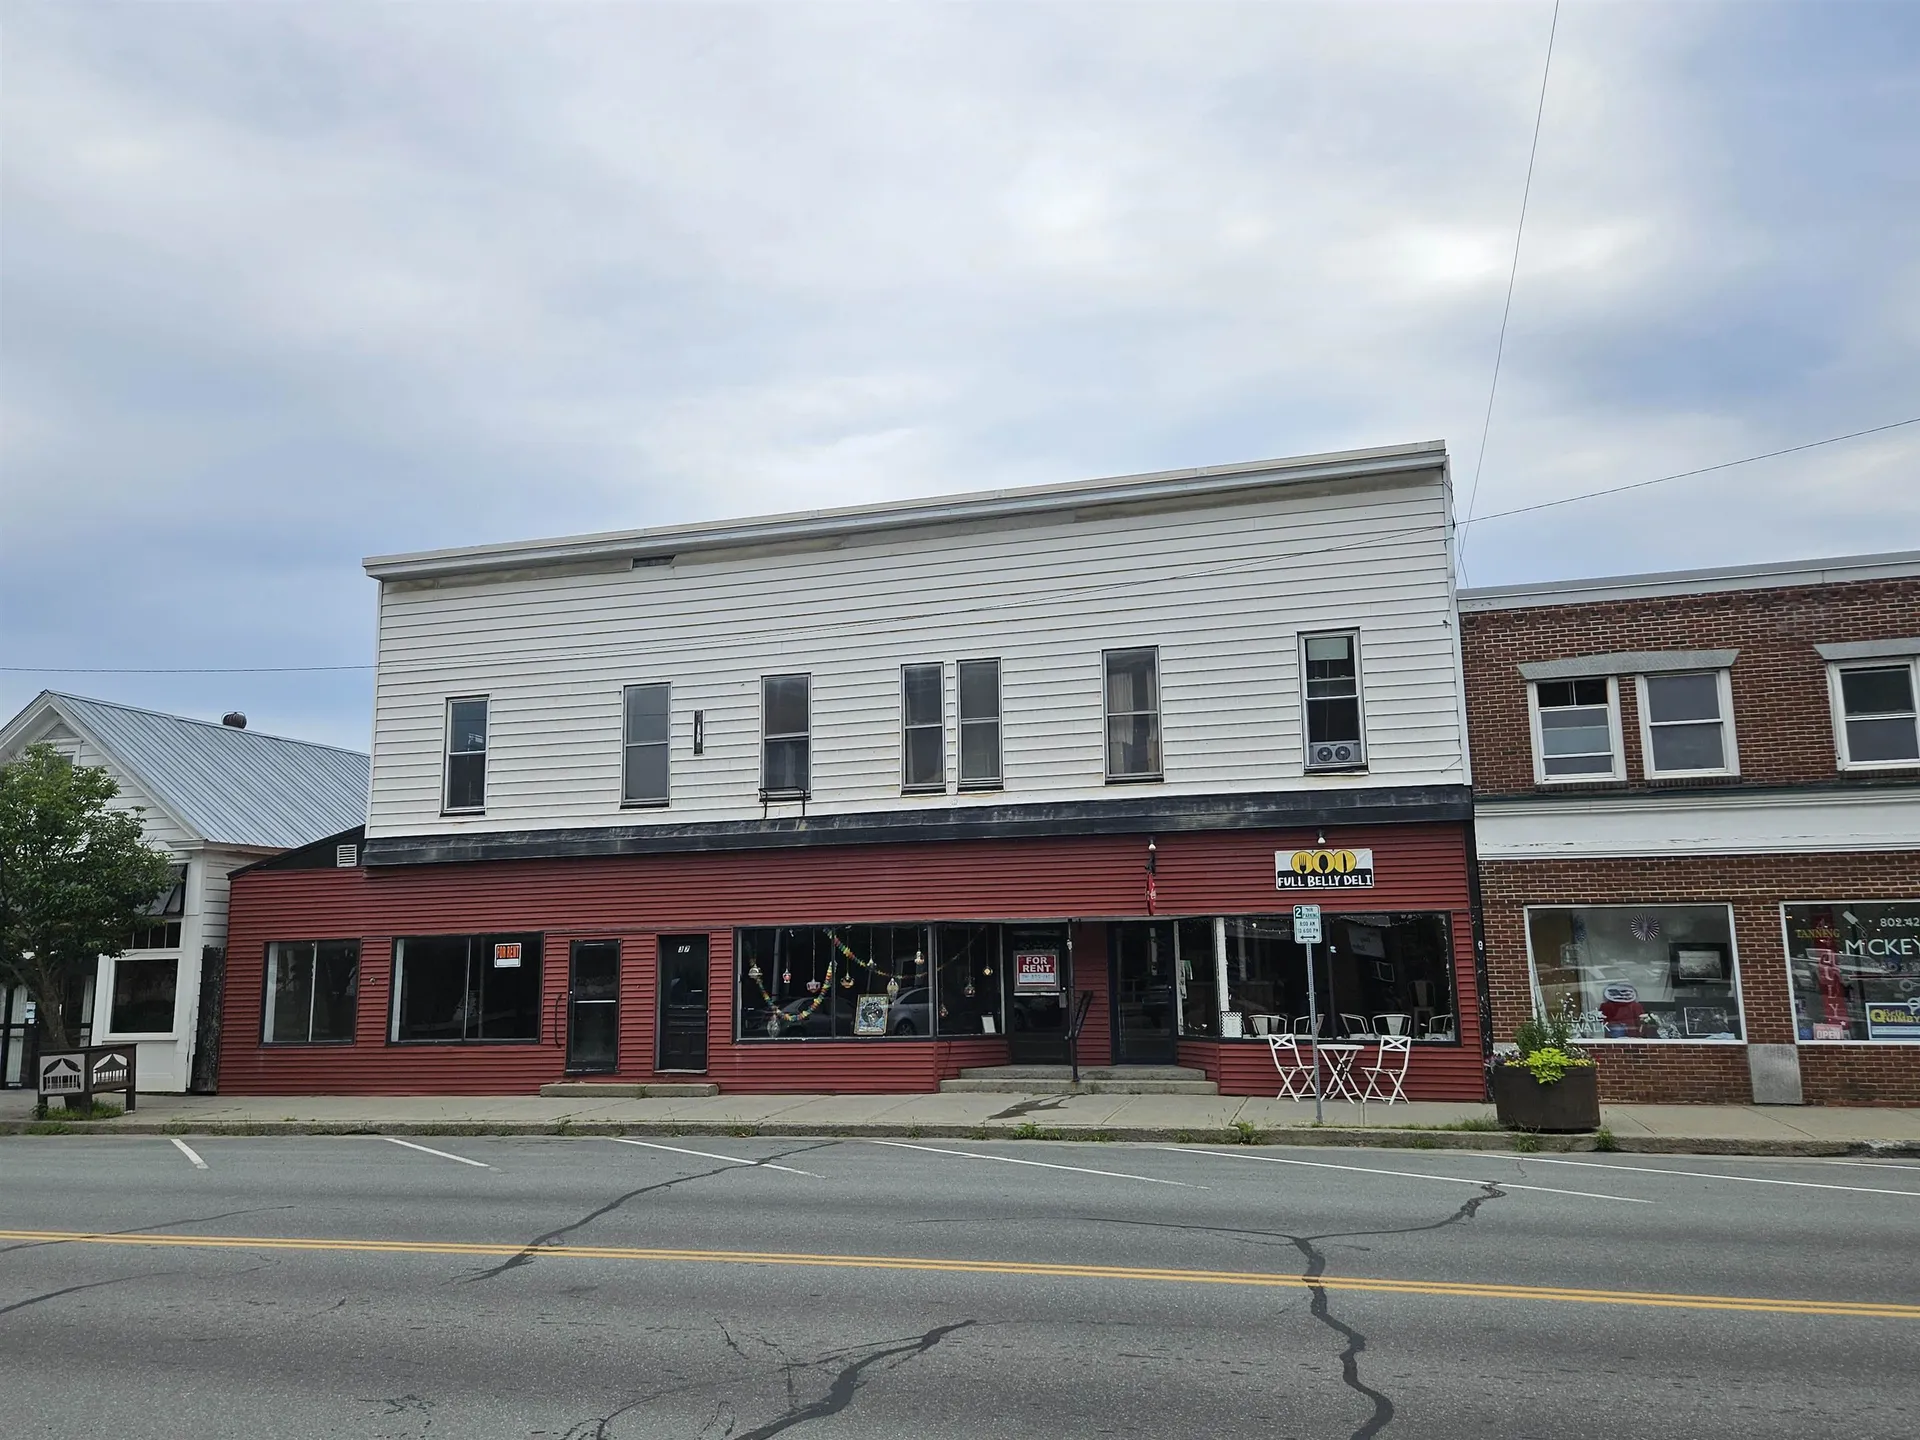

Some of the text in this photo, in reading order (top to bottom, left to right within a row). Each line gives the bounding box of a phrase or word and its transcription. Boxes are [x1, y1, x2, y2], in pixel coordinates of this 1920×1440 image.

[1278, 875, 1371, 887] FULL BELLY DELI
[1296, 908, 1301, 917] 2
[1795, 928, 1841, 939] TANNING
[1026, 956, 1047, 964] FOR
[1022, 964, 1051, 973] RENT
[1816, 1029, 1841, 1040] OPEN
